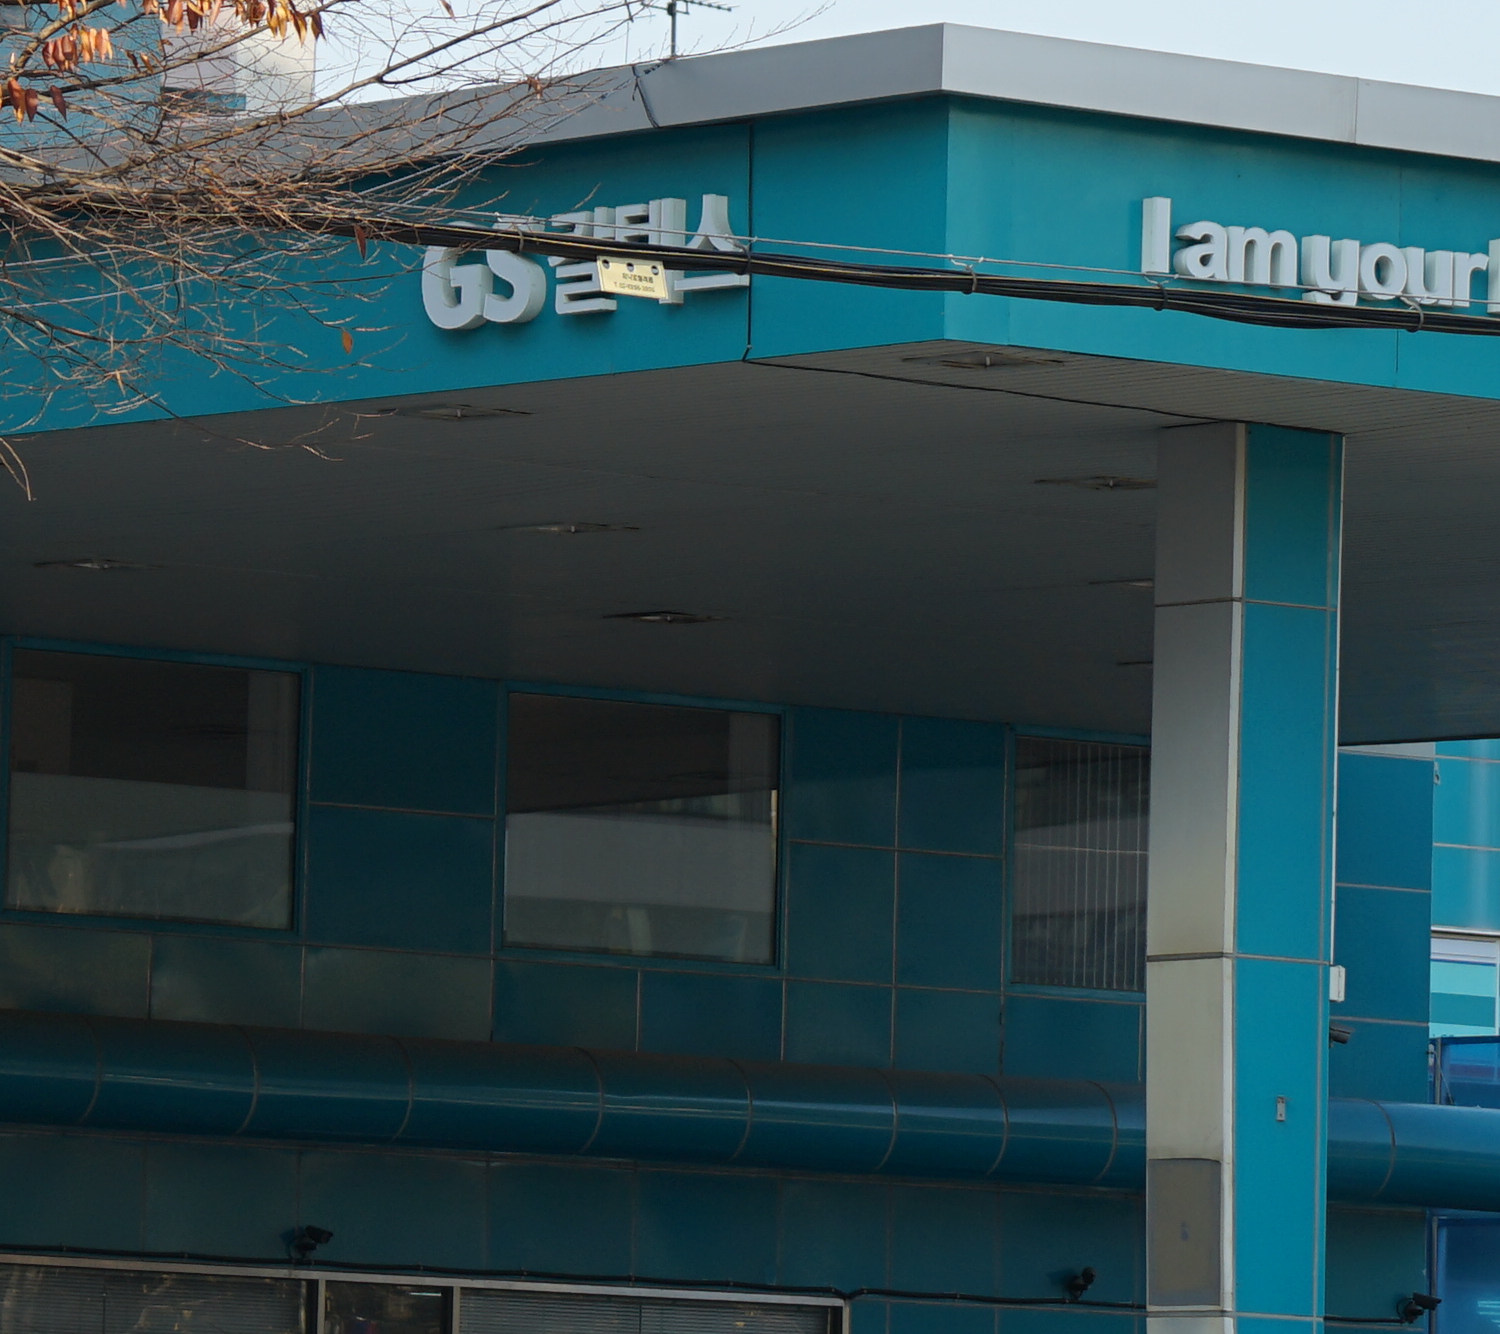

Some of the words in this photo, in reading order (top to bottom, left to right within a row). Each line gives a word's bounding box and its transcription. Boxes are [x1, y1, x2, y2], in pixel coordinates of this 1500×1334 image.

[1142, 196, 1172, 275] I
[1174, 220, 1298, 288] am
[1301, 234, 1489, 308] your
